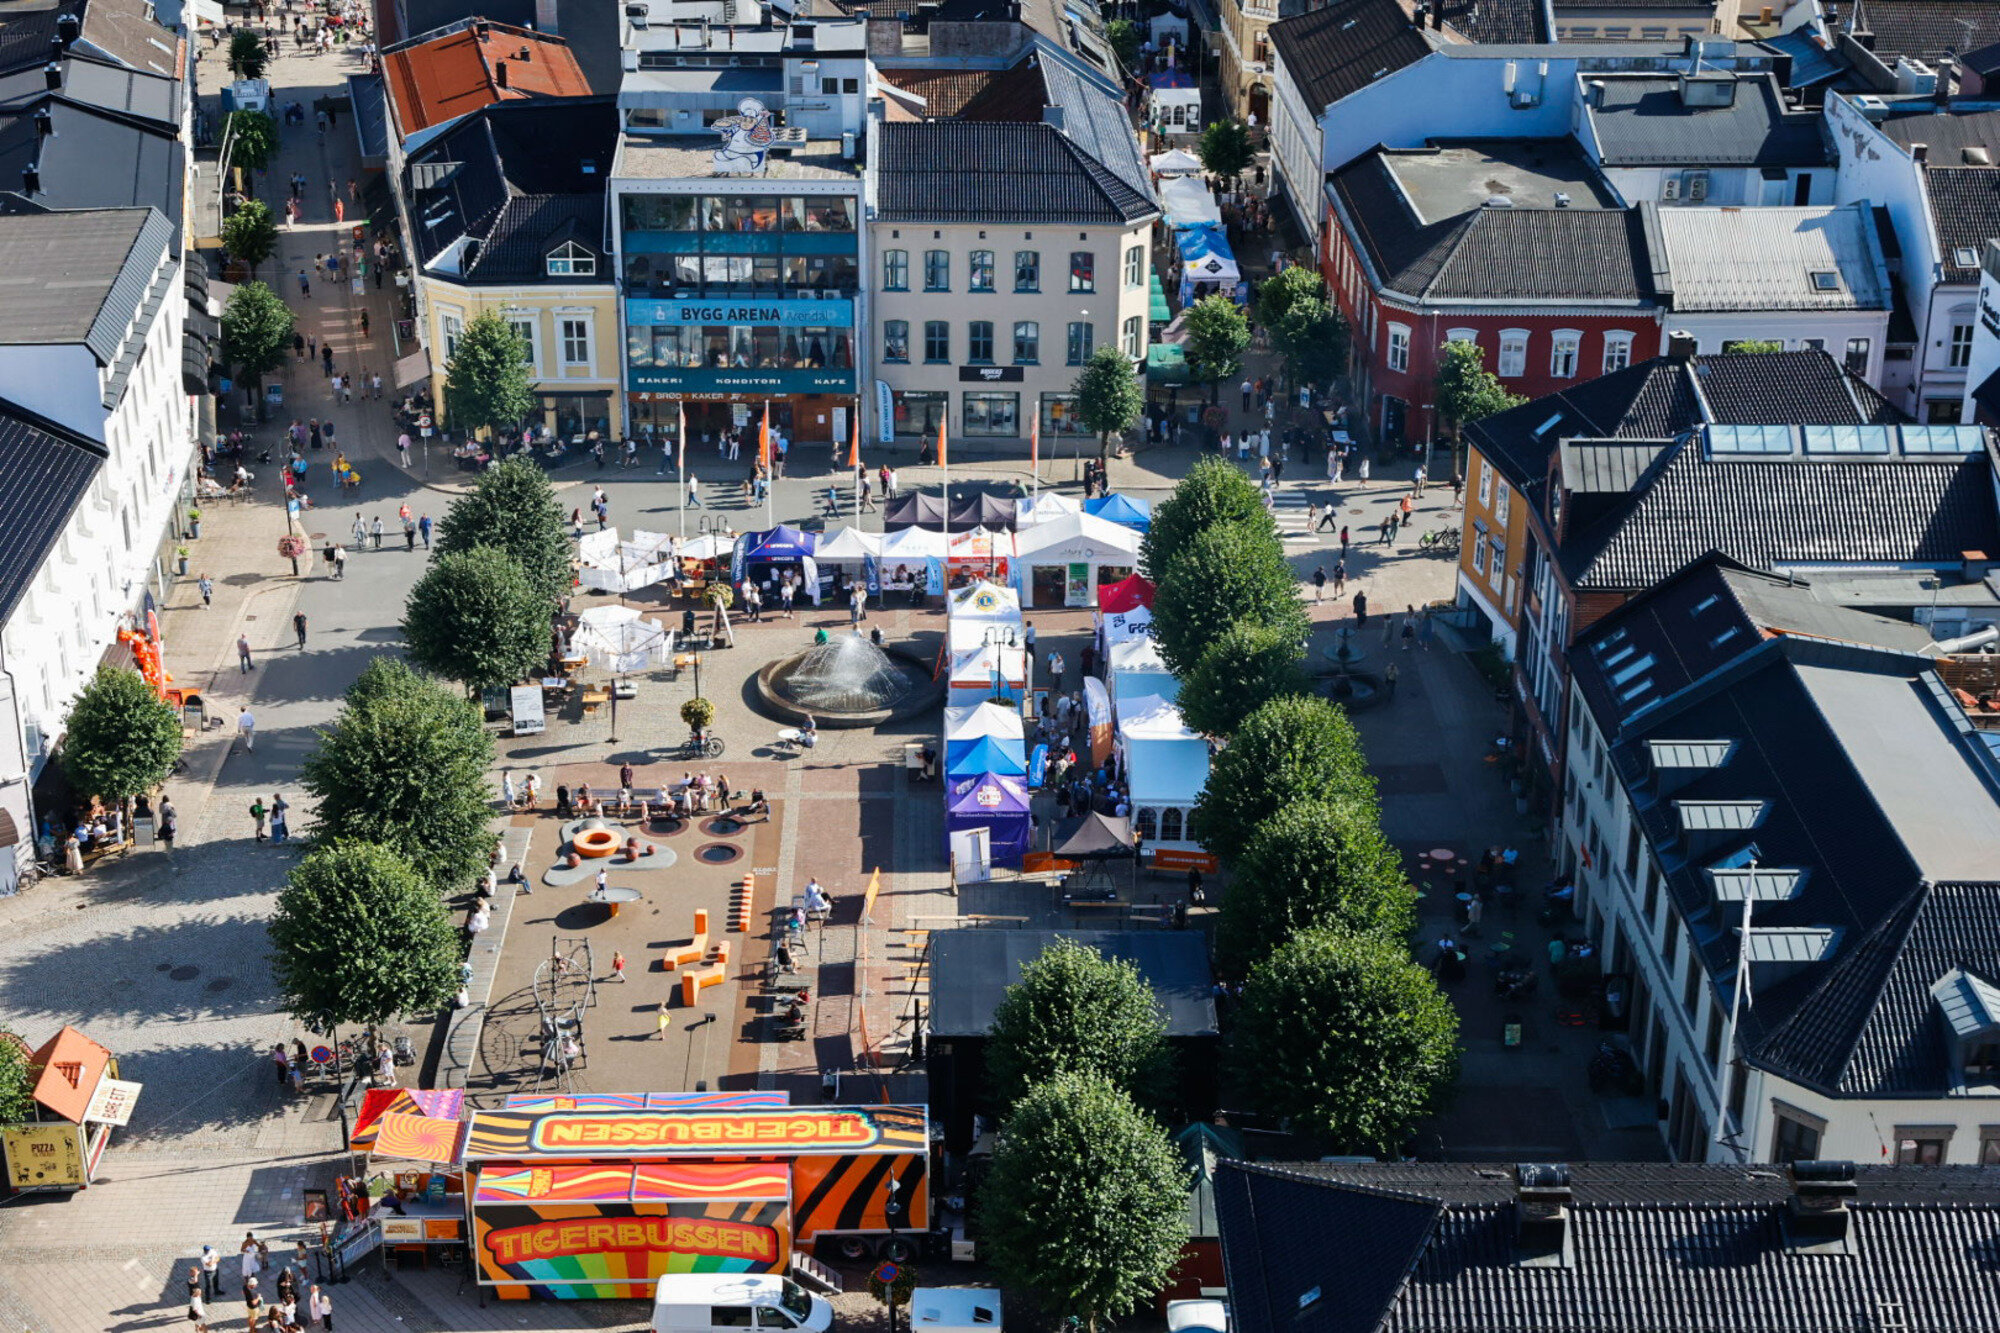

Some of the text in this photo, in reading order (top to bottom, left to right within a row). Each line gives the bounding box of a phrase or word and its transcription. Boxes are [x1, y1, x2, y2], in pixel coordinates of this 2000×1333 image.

[681, 307, 723, 322] BYGG
[727, 307, 781, 322] ARENA
[691, 392, 724, 400] KAKER
[551, 1120, 862, 1141] TIGERBUSSEN
[31, 1143, 56, 1153] PIZZA
[494, 1223, 770, 1258] TIGERBUSSEN
